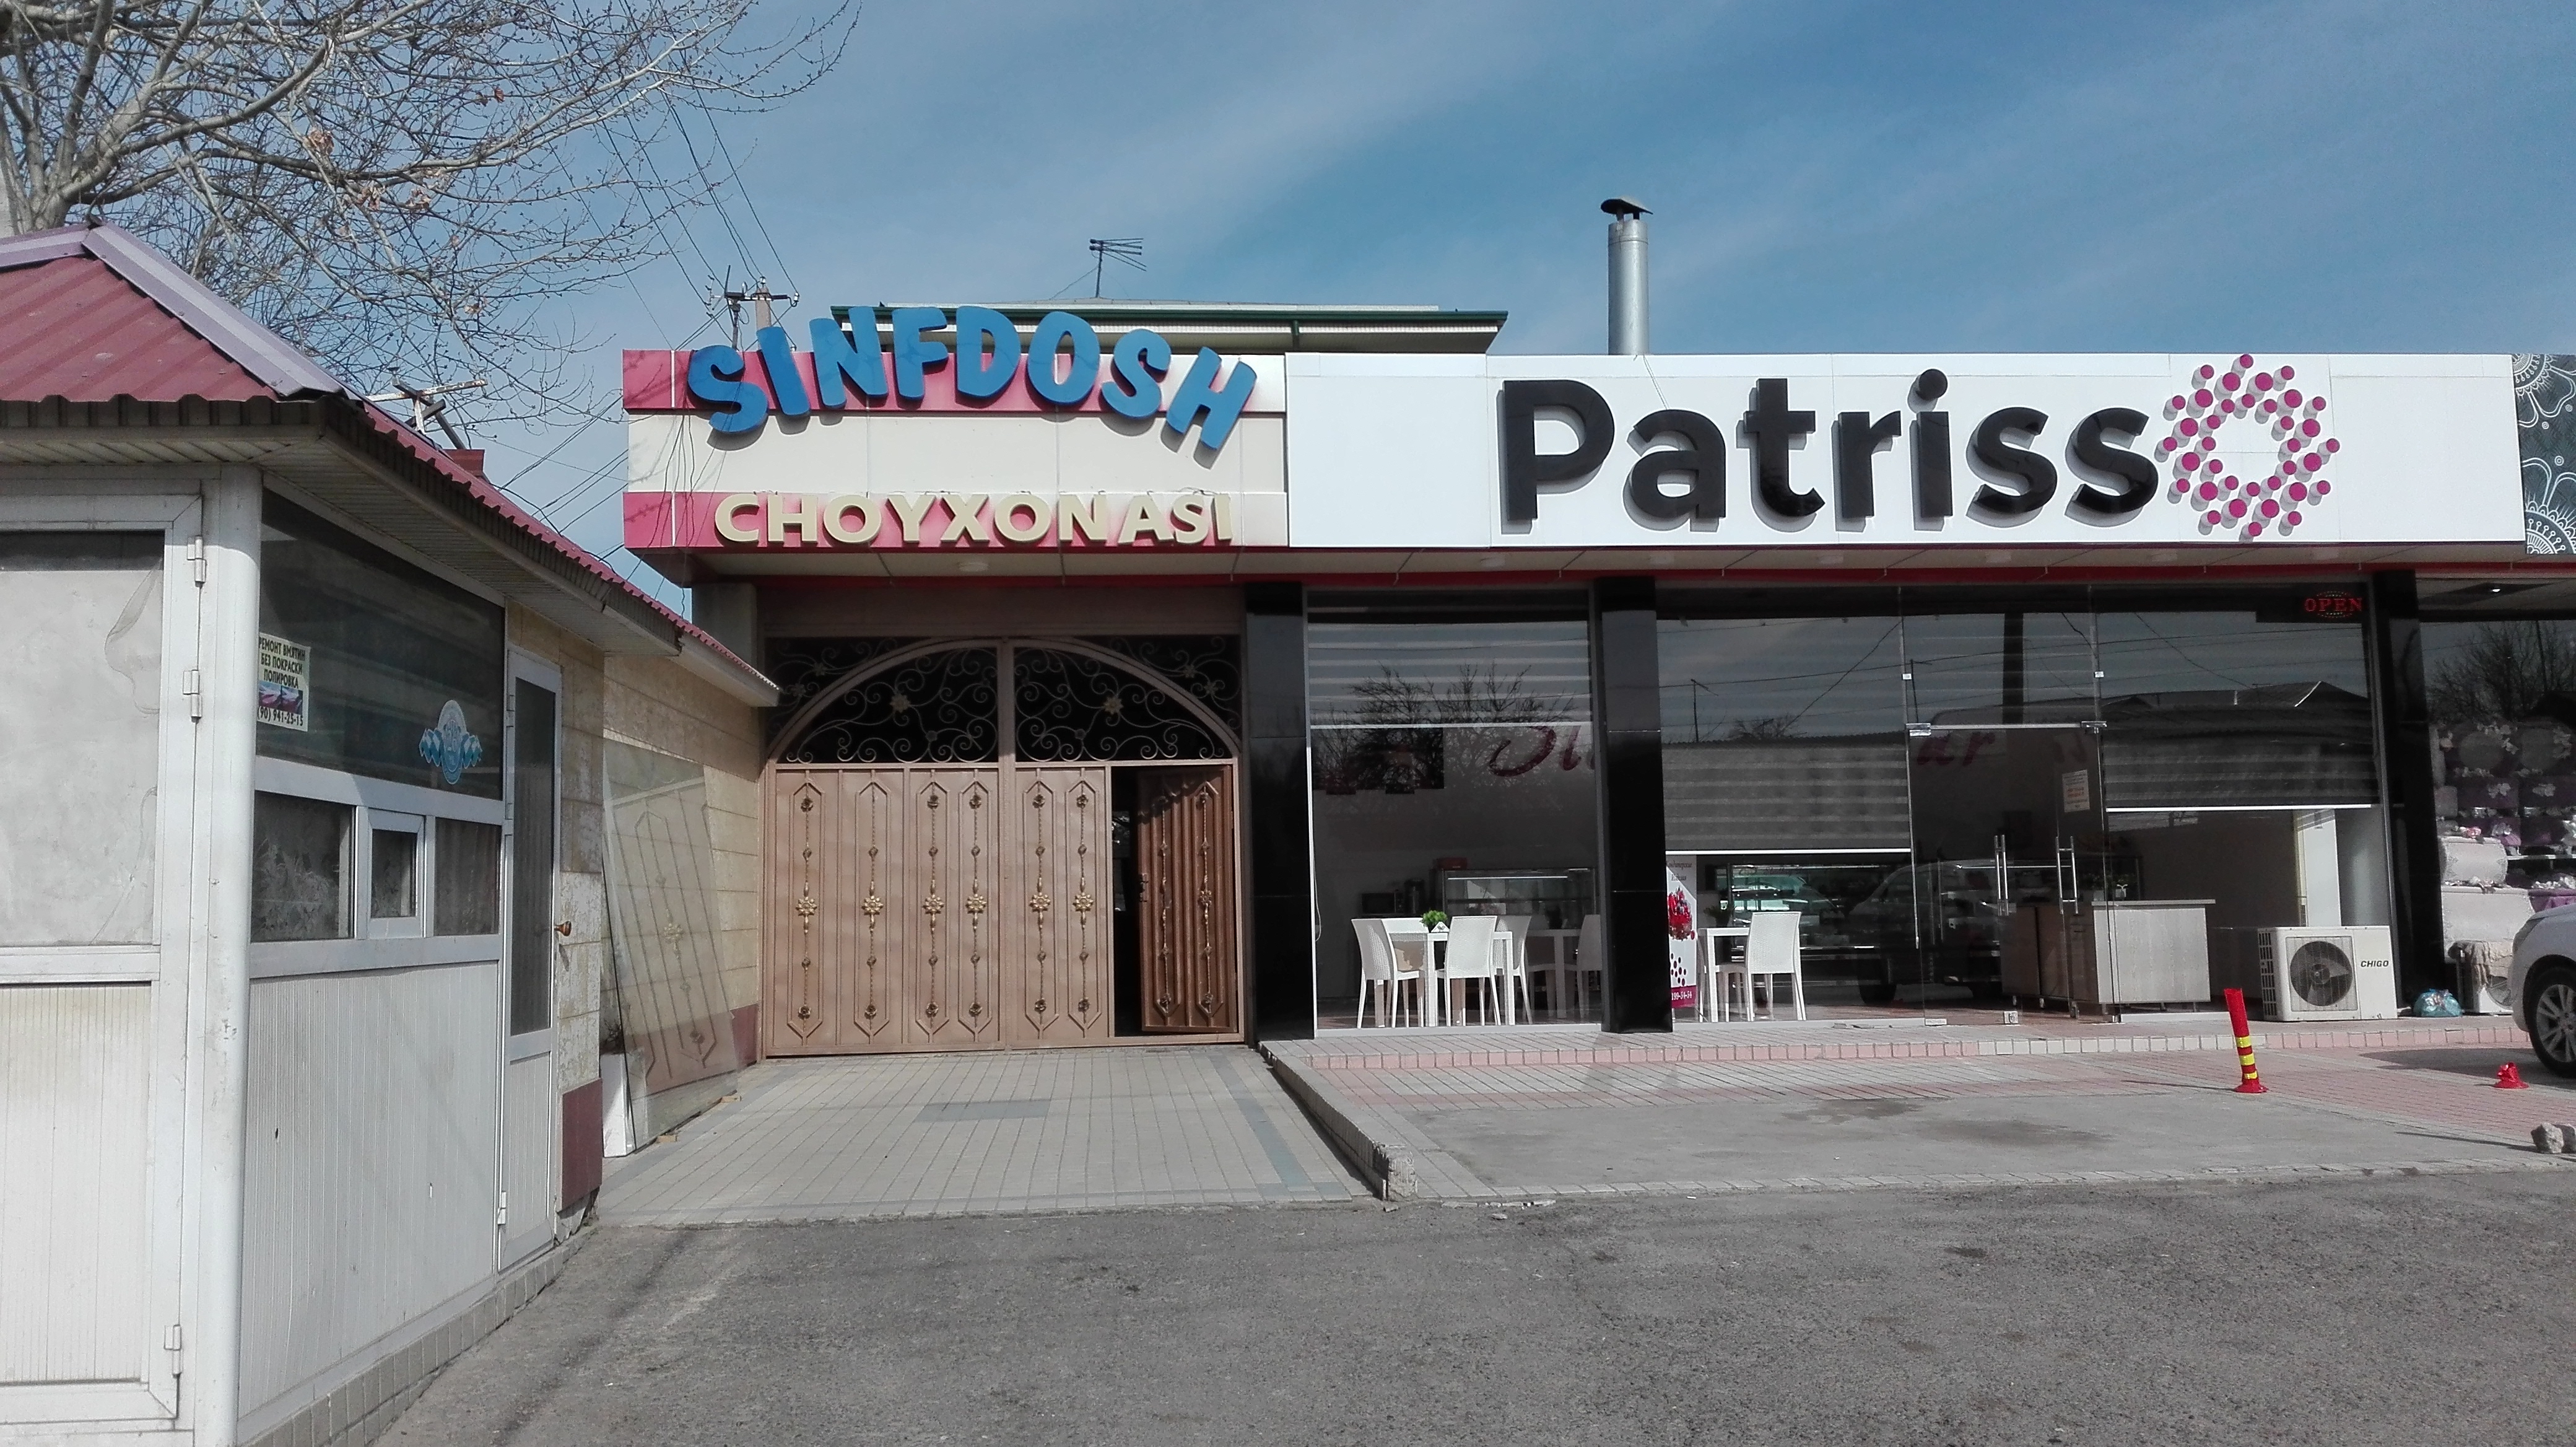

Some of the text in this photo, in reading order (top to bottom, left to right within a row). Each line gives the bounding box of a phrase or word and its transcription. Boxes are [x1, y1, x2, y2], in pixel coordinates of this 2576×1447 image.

[687, 305, 1257, 451] SINFDOSH
[1501, 368, 2159, 522] Patriss
[714, 493, 1233, 545] CHOYXONASI
[2304, 598, 2362, 612] OPEN
[259, 636, 305, 661] РЕМОНТ ВМЯТИН
[261, 652, 302, 675] БЕЗ ПОКРАСКИ
[258, 706, 303, 726] (90) 941-25-15
